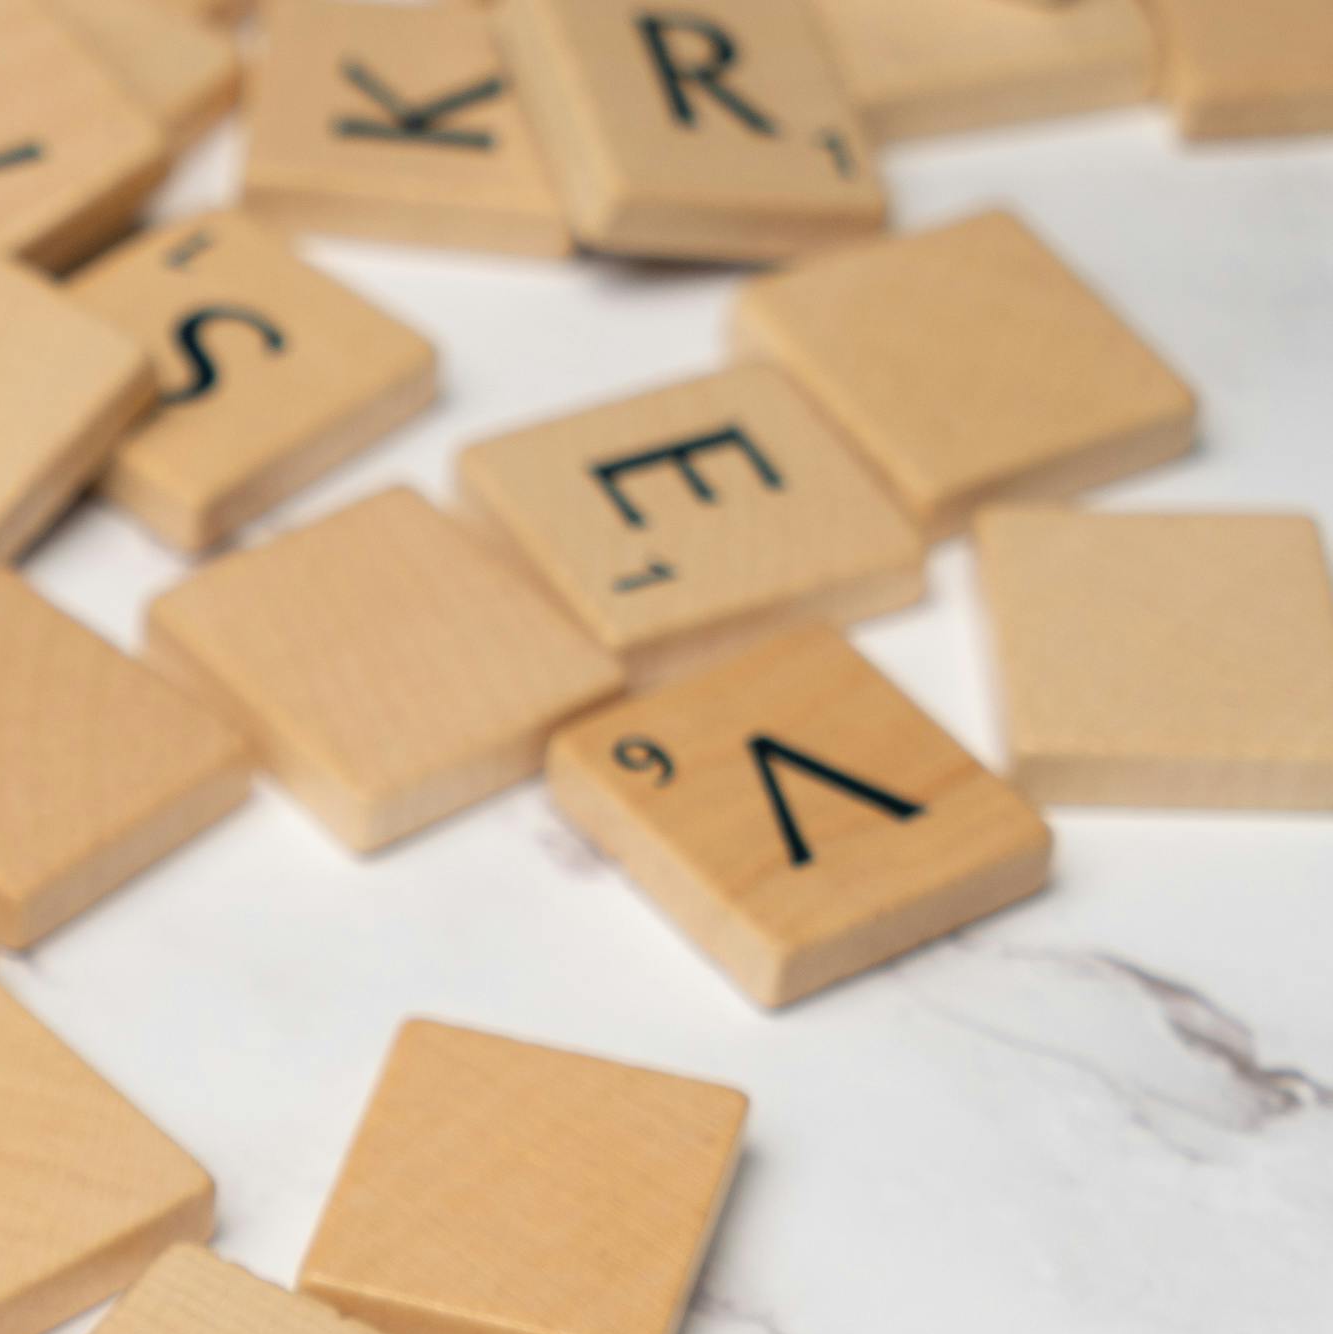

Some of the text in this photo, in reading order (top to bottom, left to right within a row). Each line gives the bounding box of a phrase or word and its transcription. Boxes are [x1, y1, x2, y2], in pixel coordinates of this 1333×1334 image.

[334, 65, 505, 151] K
[636, 13, 775, 135] R
[146, 305, 285, 410] S
[588, 423, 784, 595] E 1
[746, 733, 926, 868] V
